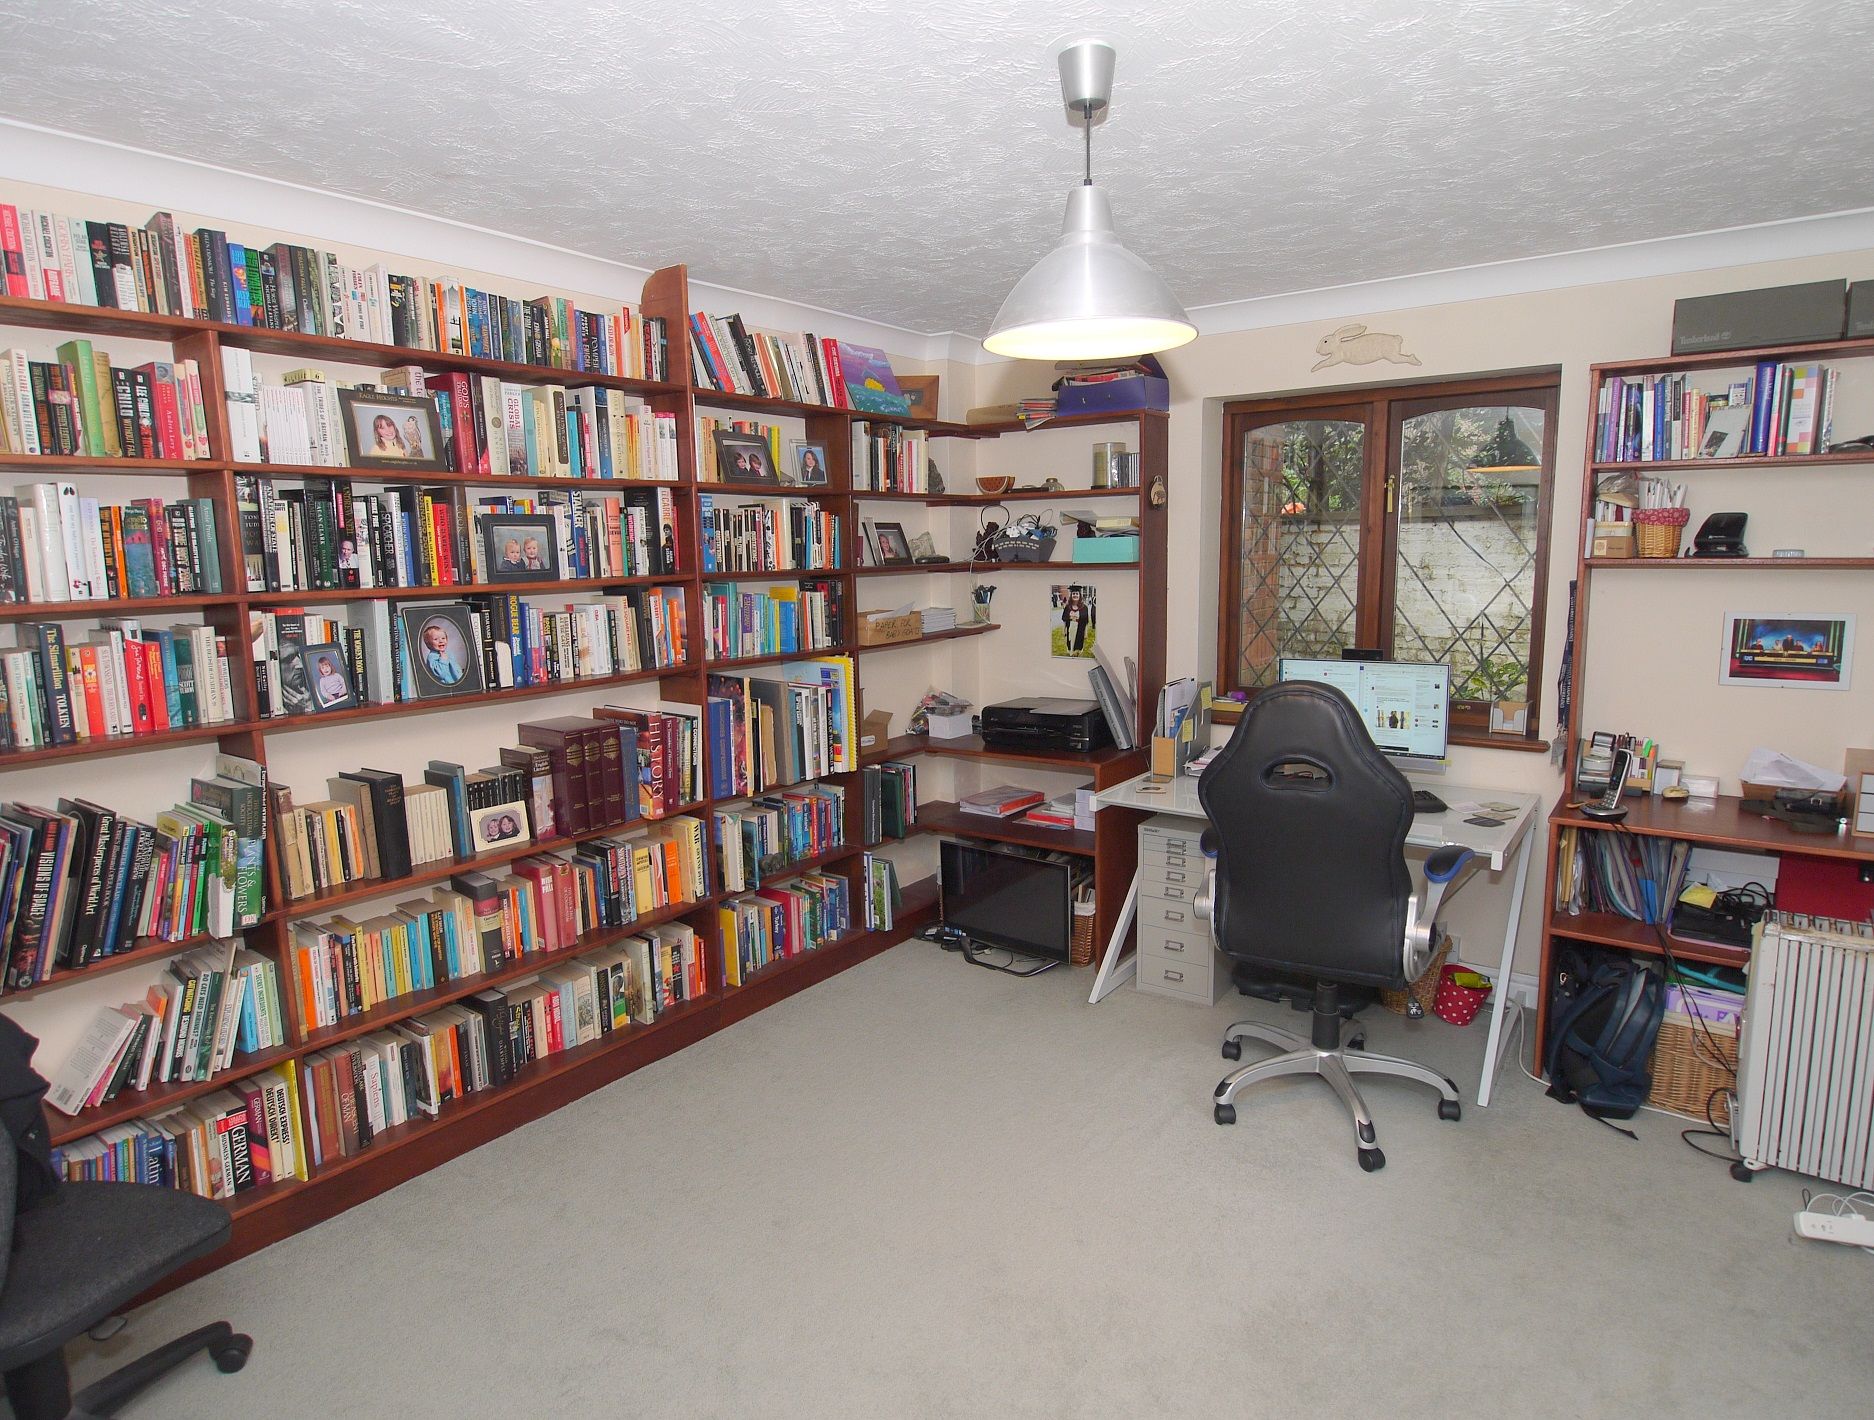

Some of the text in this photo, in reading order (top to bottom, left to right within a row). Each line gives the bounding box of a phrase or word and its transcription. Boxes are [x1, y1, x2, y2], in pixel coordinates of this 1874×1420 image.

[40, 215, 51, 234] MICHAEL
[1680, 333, 1721, 345] Timberland
[583, 344, 591, 368] ENIGMA
[461, 381, 470, 408] GOD'S
[21, 394, 35, 444] ABSOLUTE FRIENDS
[116, 386, 136, 457] CHILD WITHOUT FAIL
[166, 410, 177, 449] Andrea Levy
[507, 398, 515, 429] CRISIS
[513, 398, 521, 430] GLOBAL
[59, 427, 71, 449] LEATHER
[202, 505, 210, 522] Annie
[268, 497, 276, 522] AFFAIR
[316, 505, 324, 522] ALAN
[343, 486, 354, 536] ANDREW NEIL
[418, 491, 427, 534] TORNADO
[456, 505, 465, 533] COOK
[572, 491, 584, 529] STALKER
[270, 523, 278, 533] OF
[271, 534, 279, 553] STATE
[317, 524, 326, 545] CLARK
[380, 513, 394, 555] SPYCATCHER
[439, 528, 448, 551] DARES
[173, 528, 193, 592] THE HOT ZONE
[510, 595, 519, 634] ROGUE BEAR
[130, 645, 142, 656] Sue
[205, 650, 214, 672] BEDSIDE
[353, 629, 364, 674] THE WOMEN'S ROOM
[46, 628, 70, 728] The Silmarillion TOLKIEN
[208, 673, 216, 700] GUARDIAN
[650, 723, 663, 800] HISTORY
[246, 792, 254, 836] HORTICULTURAL
[85, 816, 113, 915] Great Masterpieces of World Art
[247, 839, 257, 877] PLANTS
[30, 851, 55, 916] VISIONS OF SPACE
[237, 866, 248, 913] FLOWERS
[200, 983, 208, 996] CATS
[202, 973, 210, 982] DO
[183, 980, 196, 1013] CATWATCHING
[255, 973, 267, 1017] SECRET INGREDIENTS
[179, 1014, 190, 1039] DESMOND
[194, 1011, 203, 1037] SHRINKS?
[371, 1072, 381, 1108] Sapiens
[253, 1098, 262, 1123] GERMAN
[266, 1087, 280, 1143] DEUTSCH DIREKT!
[276, 1089, 290, 1145] DEUTSCH EXPRESS!
[221, 1134, 232, 1186] BUSINESS GERMAN
[231, 1126, 250, 1184] GERMAN
